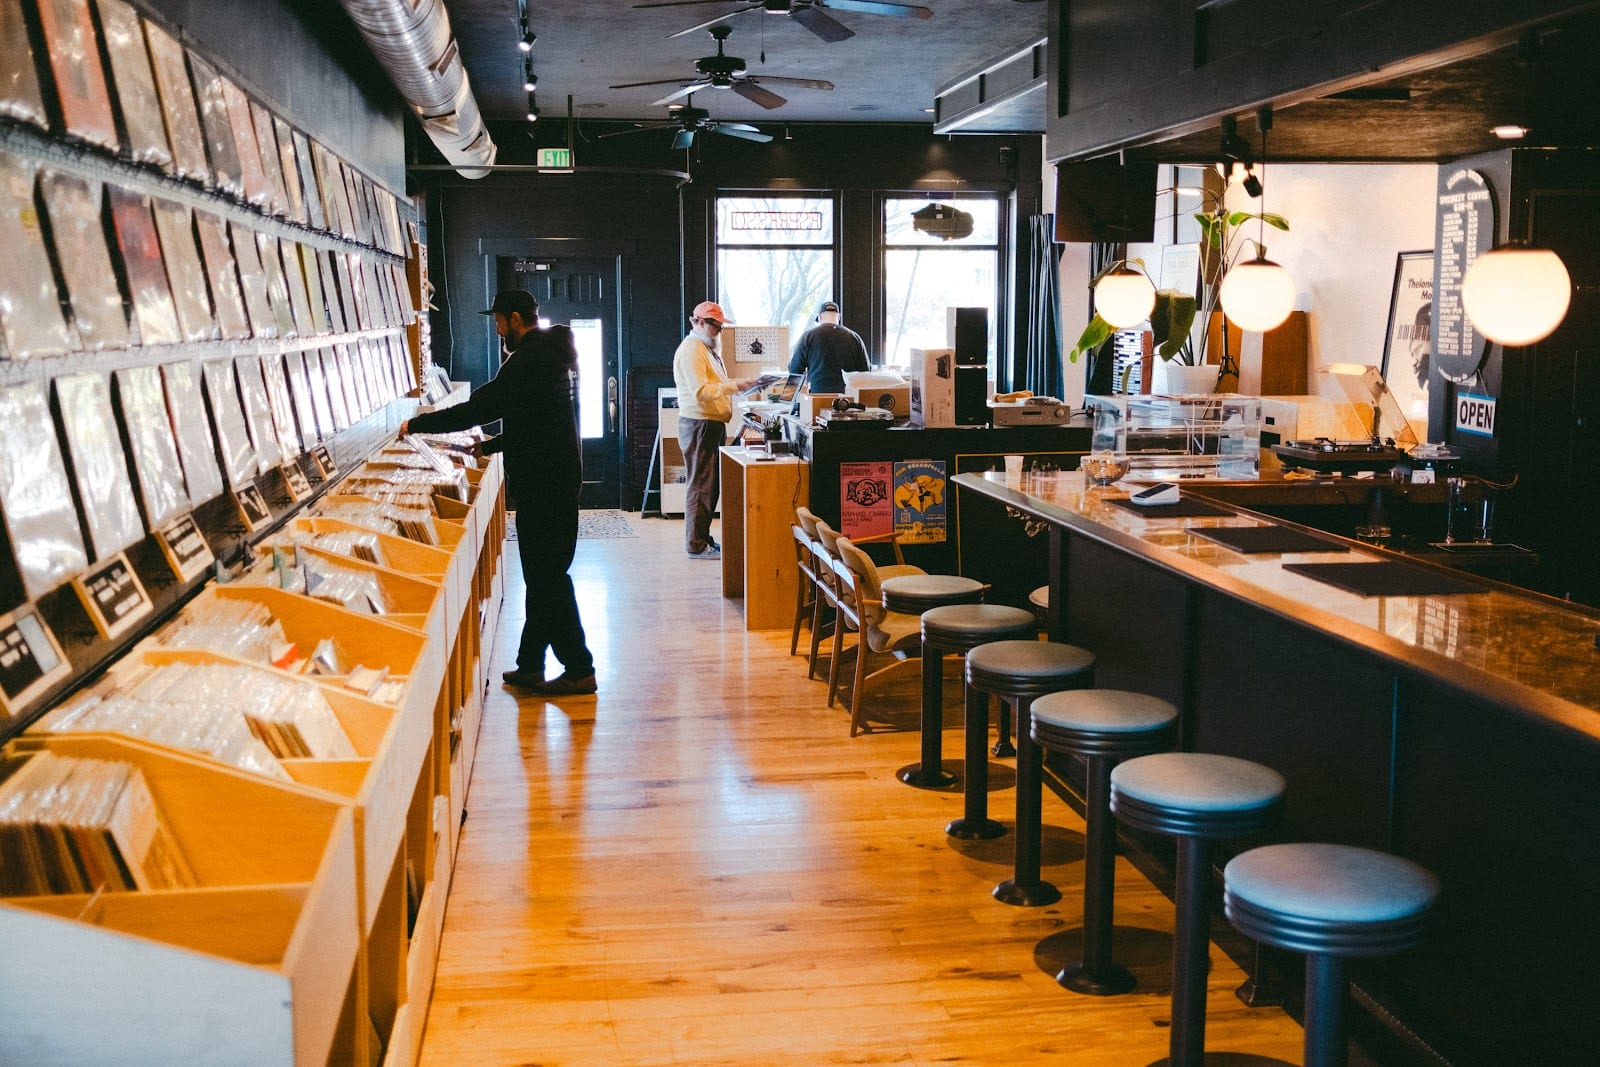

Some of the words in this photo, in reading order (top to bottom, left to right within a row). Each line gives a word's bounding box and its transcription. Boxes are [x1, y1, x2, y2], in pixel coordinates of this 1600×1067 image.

[543, 150, 570, 167] EXIT
[1467, 190, 1490, 202] COFFEE
[1408, 278, 1433, 289] Theloni
[1421, 290, 1433, 300] Mo
[1459, 400, 1493, 430] OPEN
